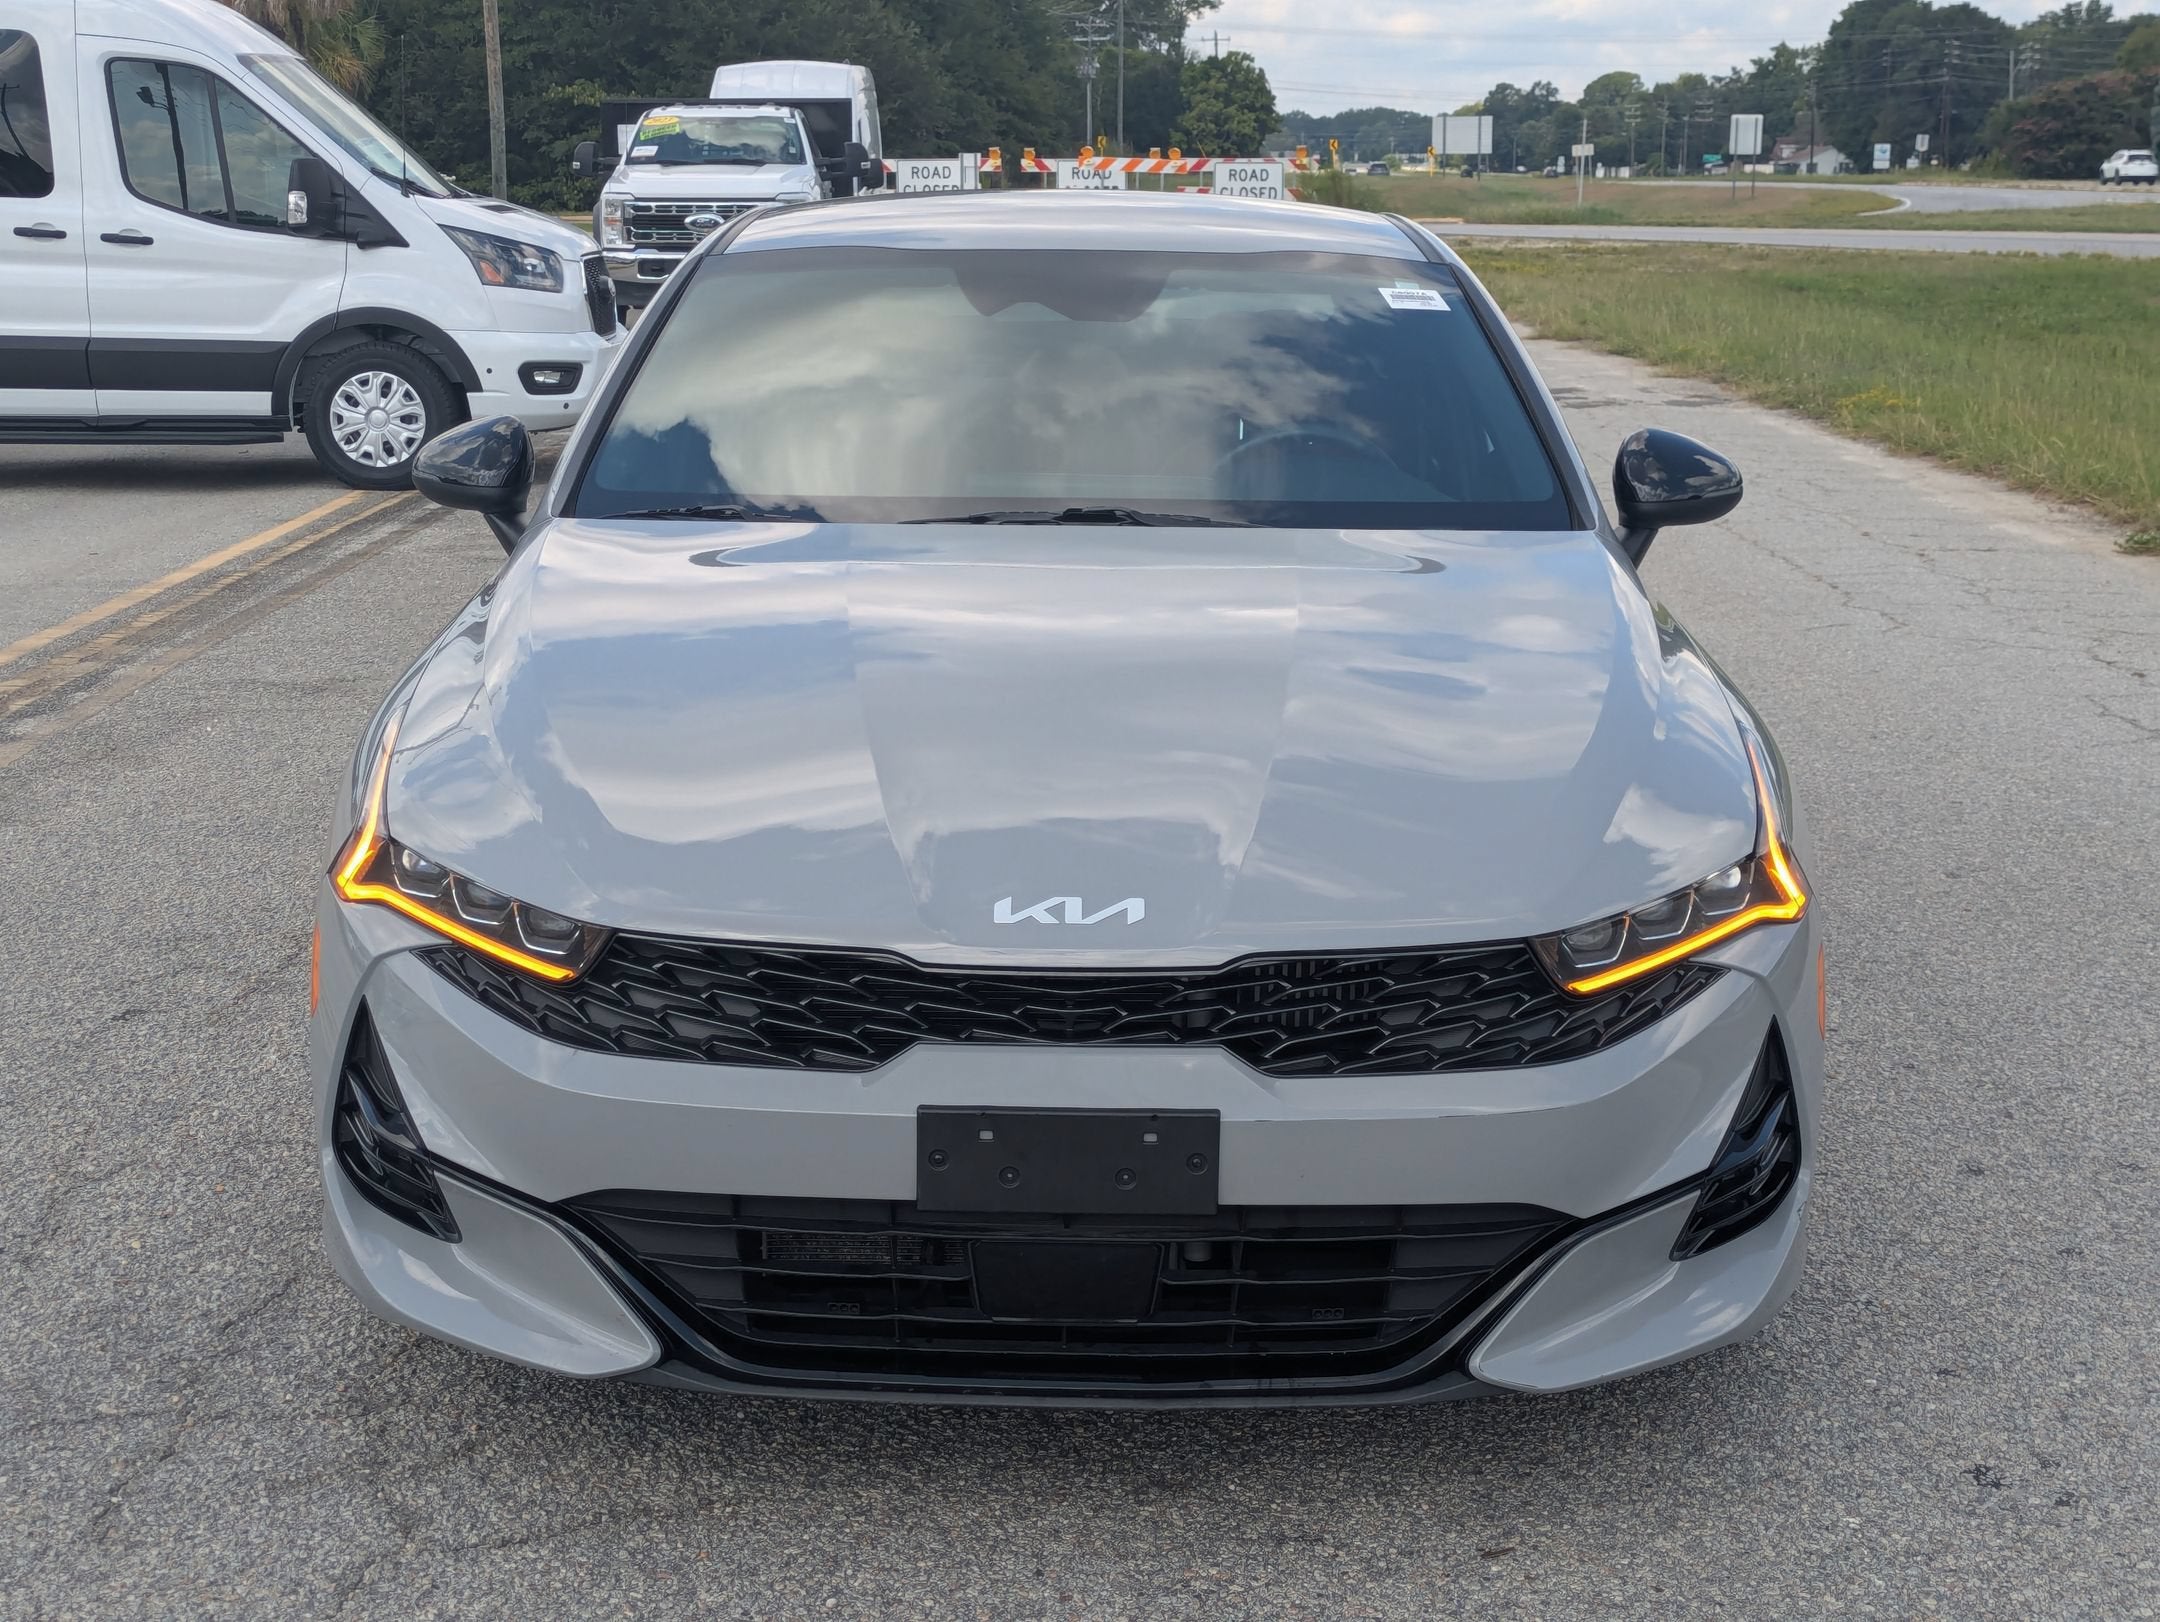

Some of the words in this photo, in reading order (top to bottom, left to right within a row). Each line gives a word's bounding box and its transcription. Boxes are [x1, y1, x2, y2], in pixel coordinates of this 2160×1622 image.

[911, 166, 951, 180] ROAD
[1071, 166, 1112, 180] ROAD
[1228, 168, 1270, 182] ROAD
[1219, 186, 1278, 200] CLOSED
[993, 896, 1145, 925] KIA
